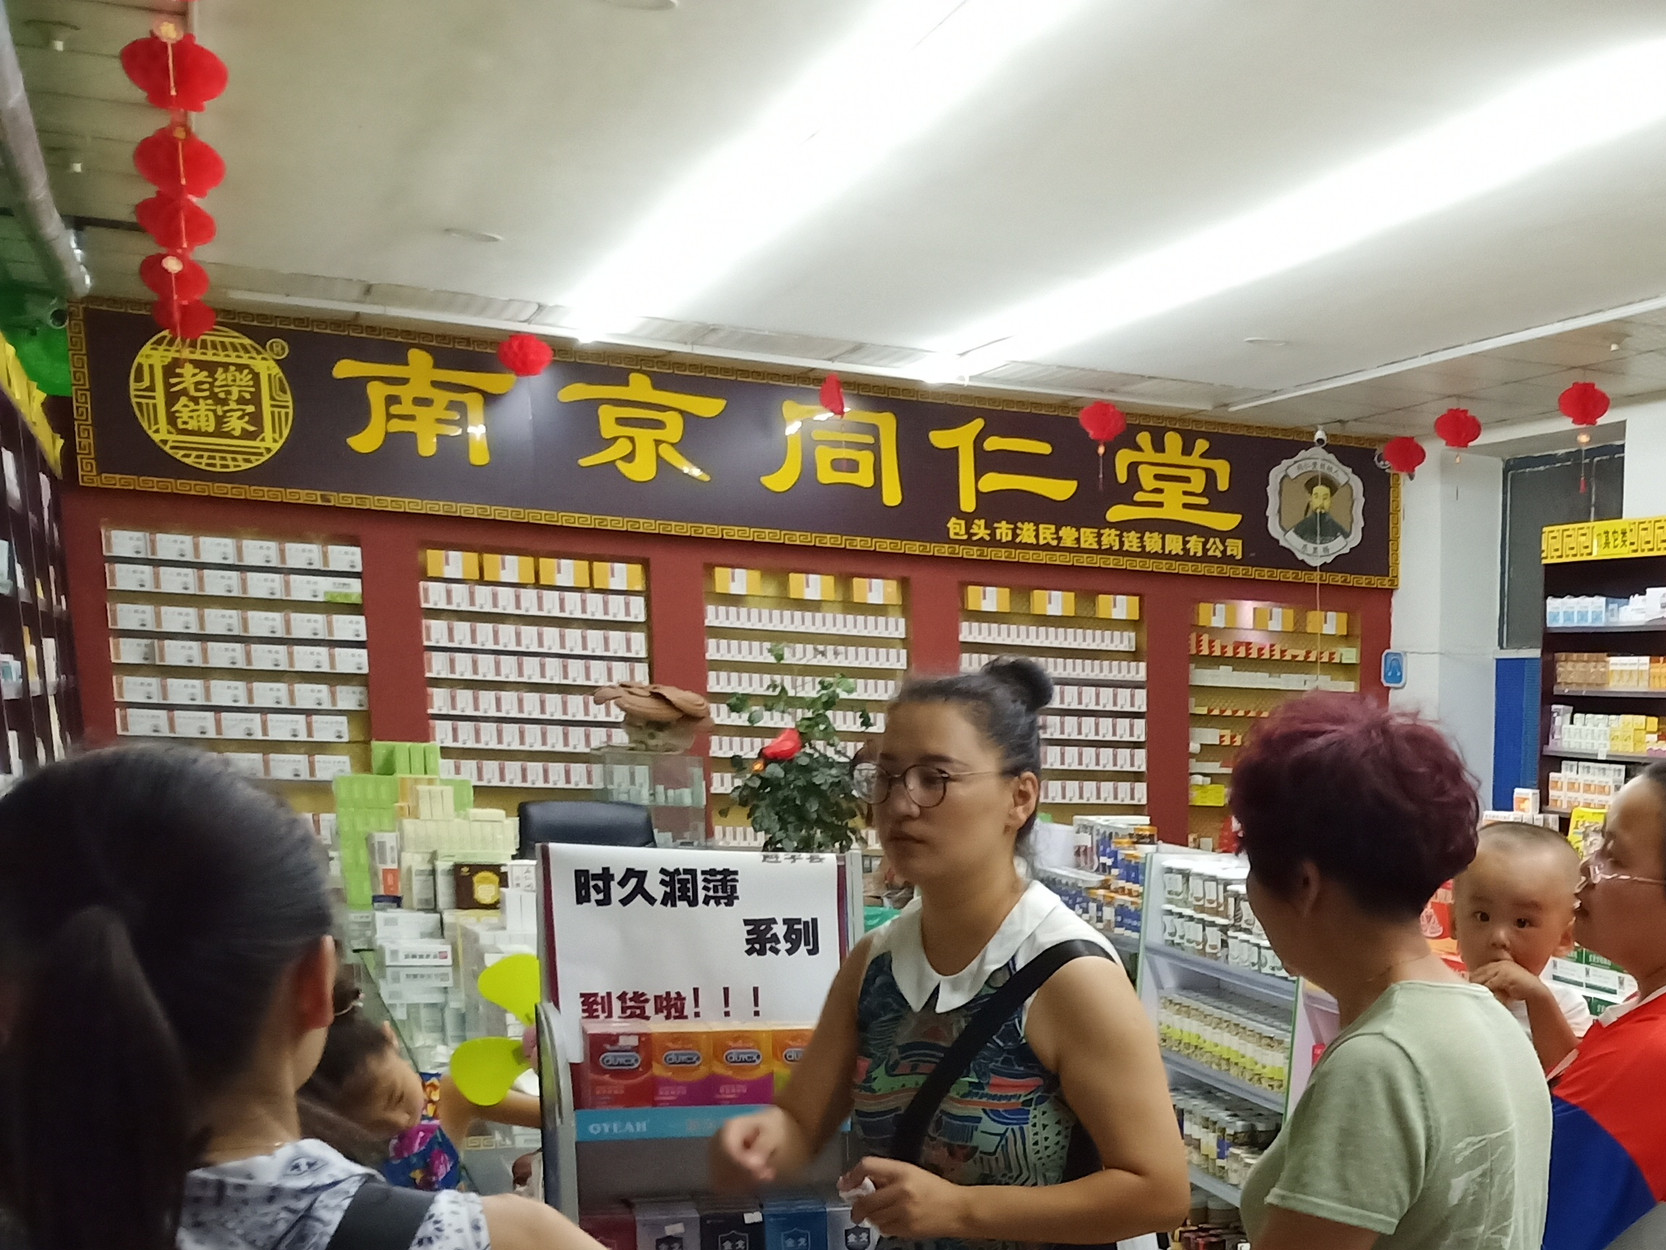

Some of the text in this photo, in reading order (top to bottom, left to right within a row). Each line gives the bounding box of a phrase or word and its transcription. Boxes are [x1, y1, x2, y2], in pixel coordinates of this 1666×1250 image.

[331, 348, 1243, 530] 南京同仁堂
[574, 866, 740, 908] 时久润薄
[743, 916, 820, 957] 系列
